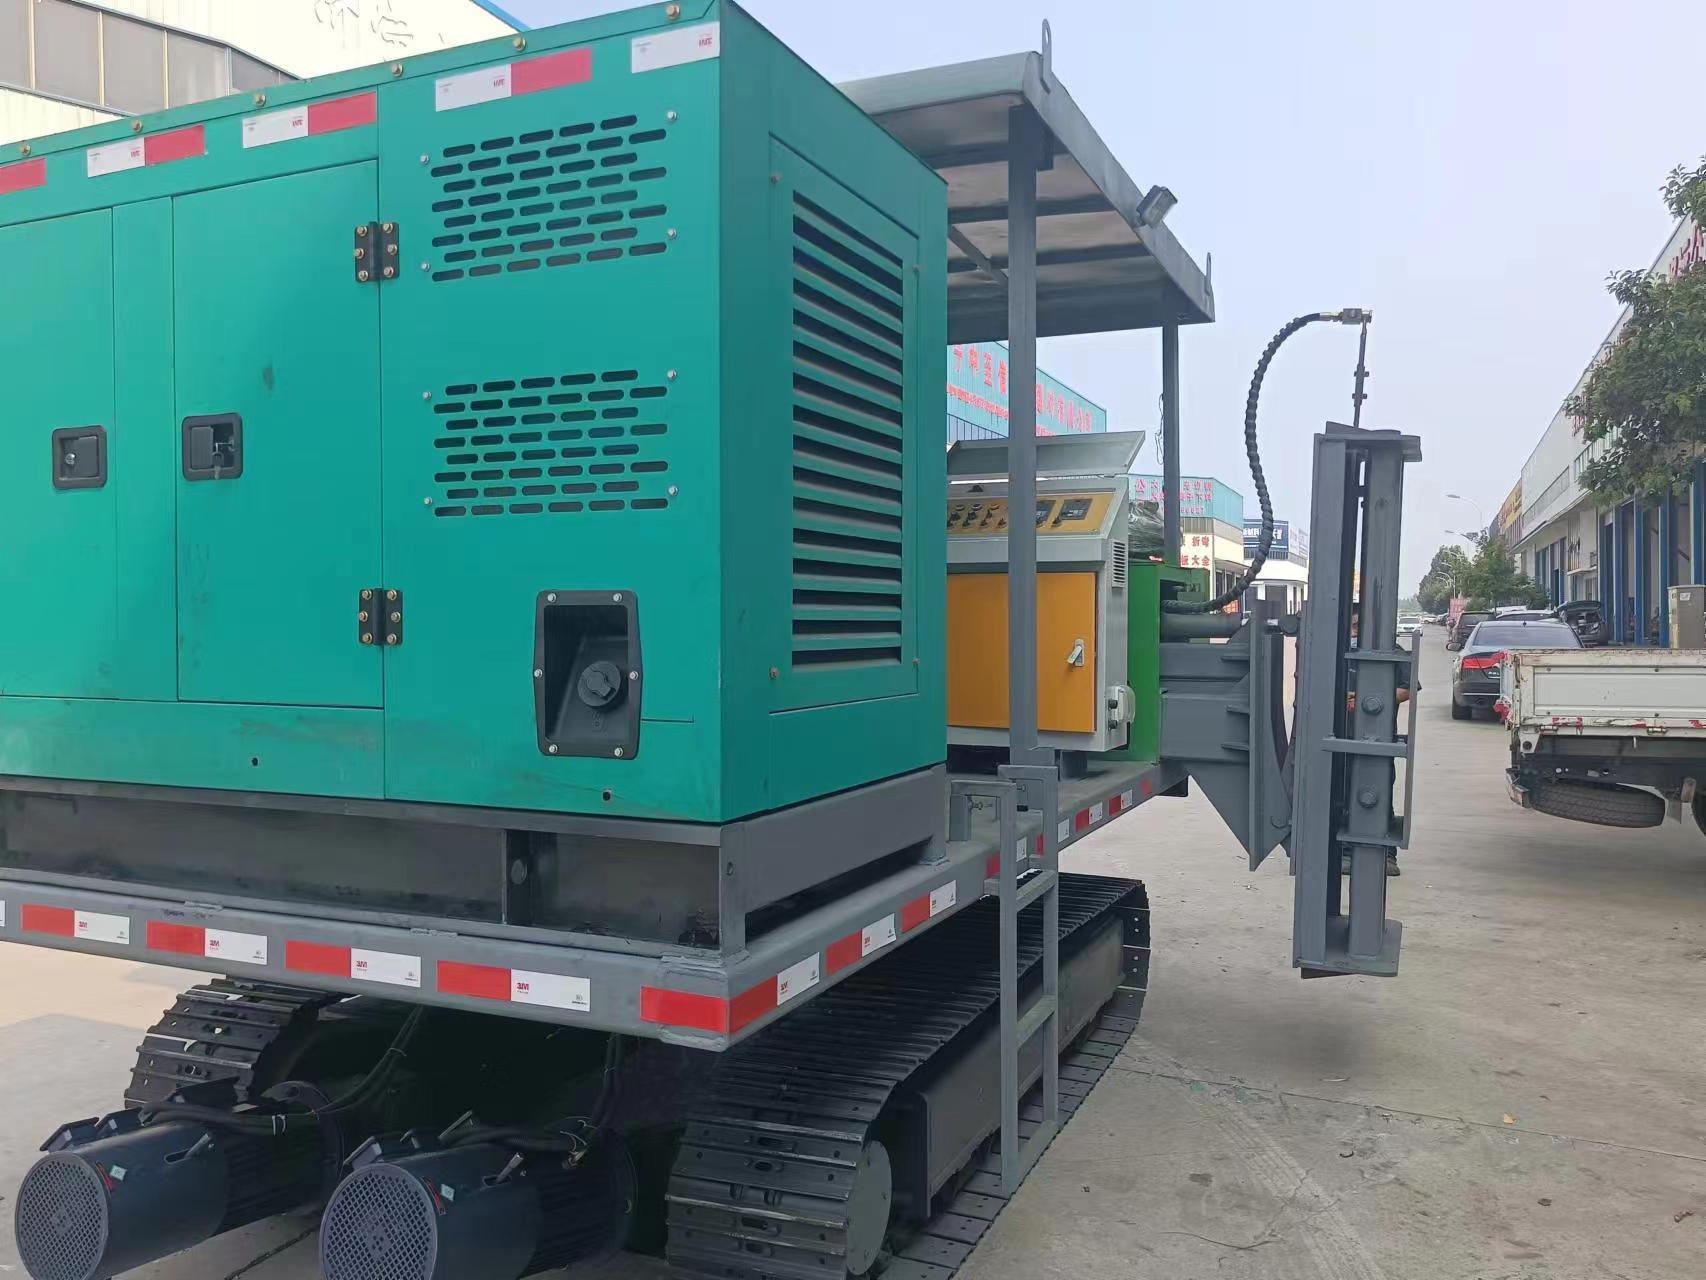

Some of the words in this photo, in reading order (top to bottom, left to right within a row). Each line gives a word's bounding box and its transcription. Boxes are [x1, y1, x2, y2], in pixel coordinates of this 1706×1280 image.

[209, 939, 220, 947] 3M
[356, 960, 368, 969] 3M
[516, 982, 529, 991] 3M
